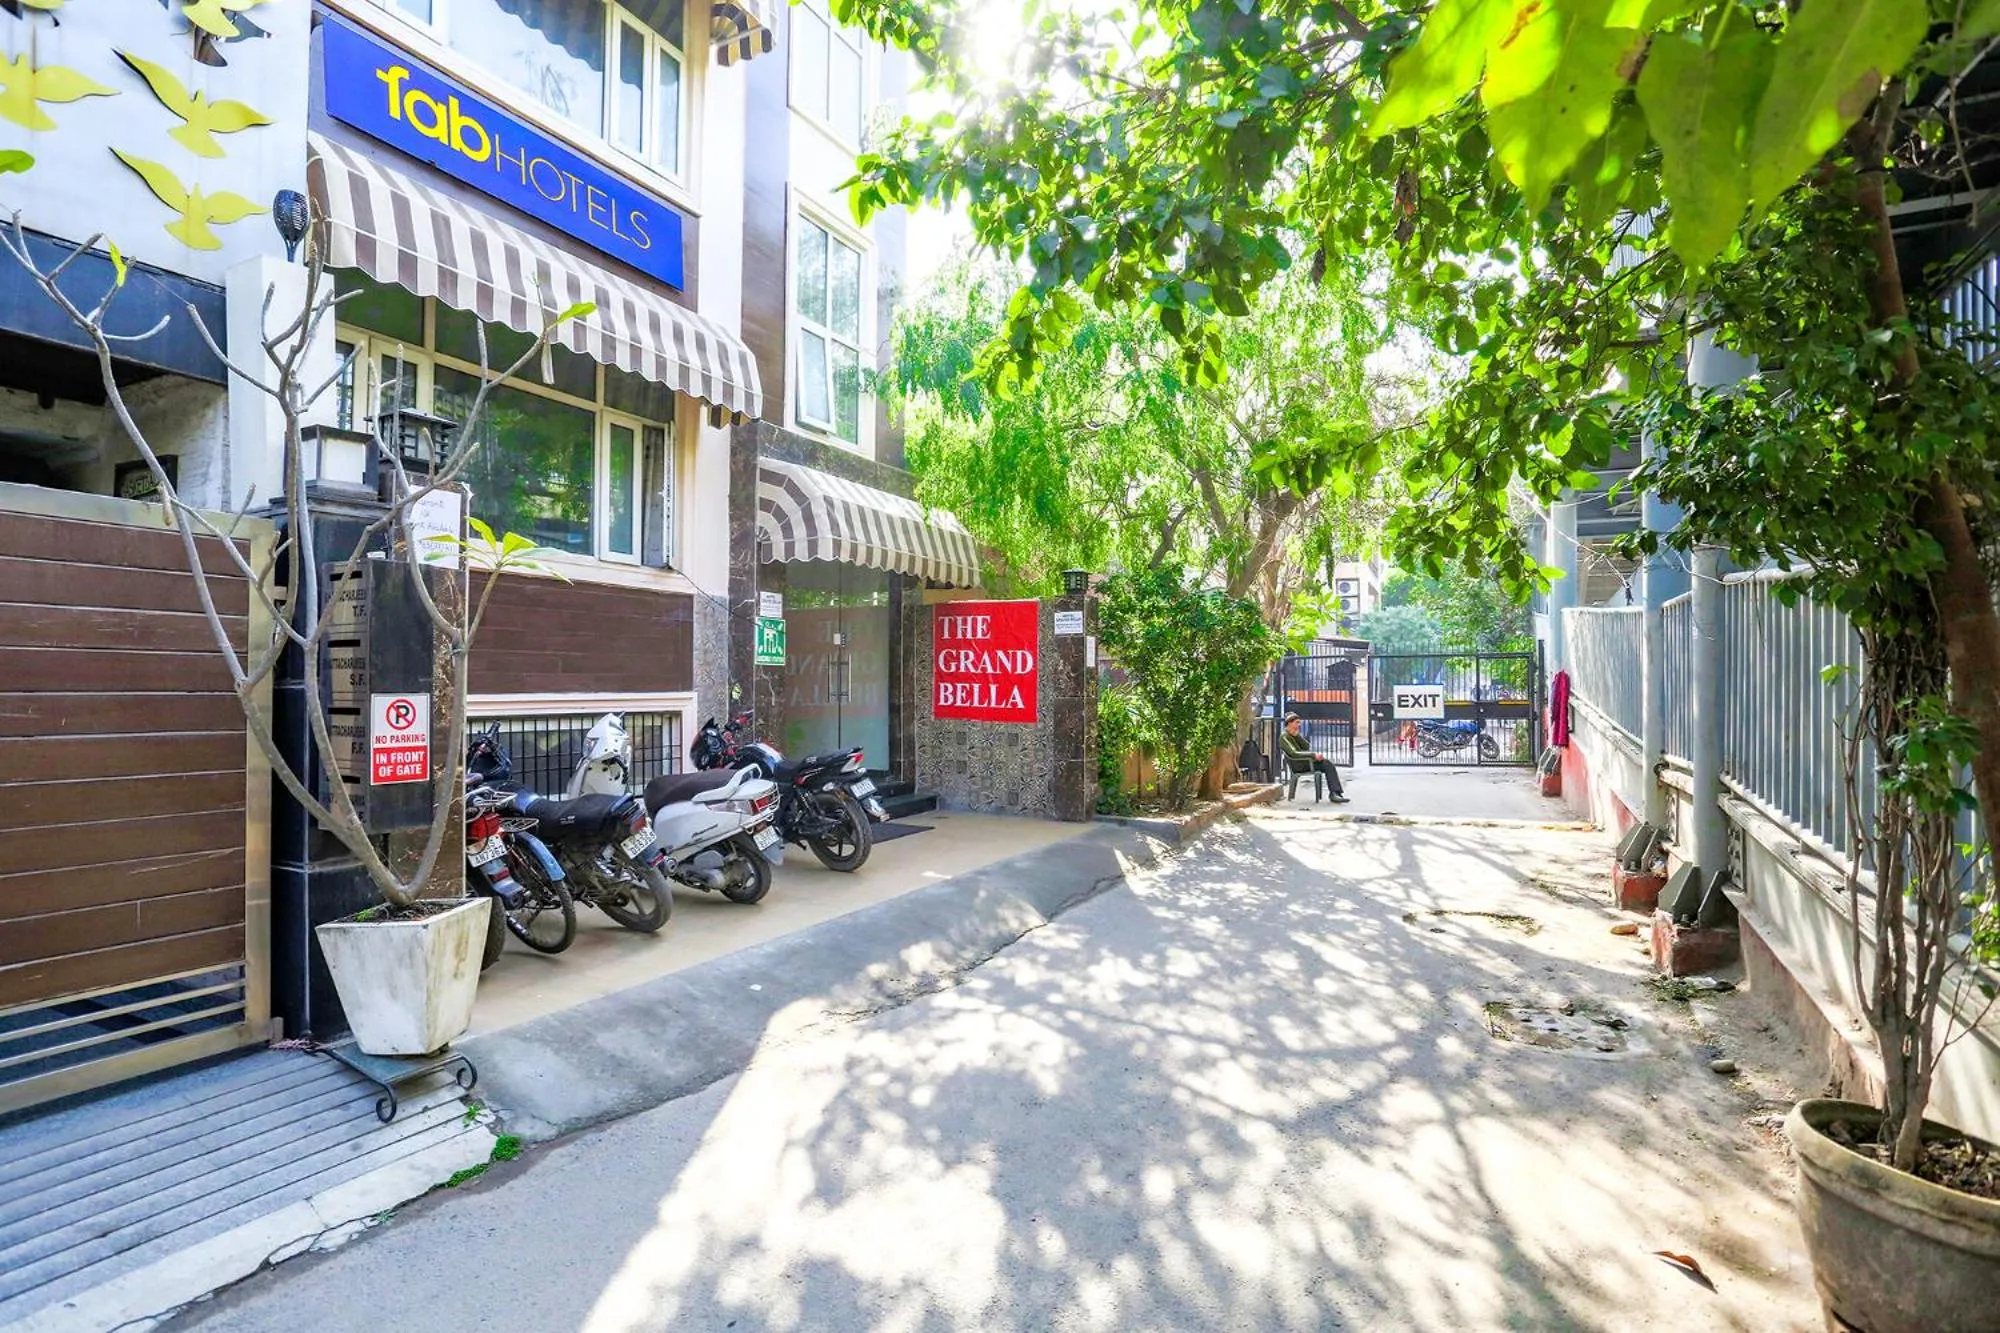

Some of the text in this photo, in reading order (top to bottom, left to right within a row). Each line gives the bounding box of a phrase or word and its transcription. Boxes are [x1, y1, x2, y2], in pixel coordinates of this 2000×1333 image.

[938, 615, 991, 641] THE
[938, 648, 1034, 675] GRAND
[938, 683, 1025, 709] BELLA
[1397, 694, 1440, 708] EXIT
[375, 733, 426, 744] NO PARKING
[376, 751, 425, 764] IN FRONT
[378, 764, 423, 777] OF GATE
